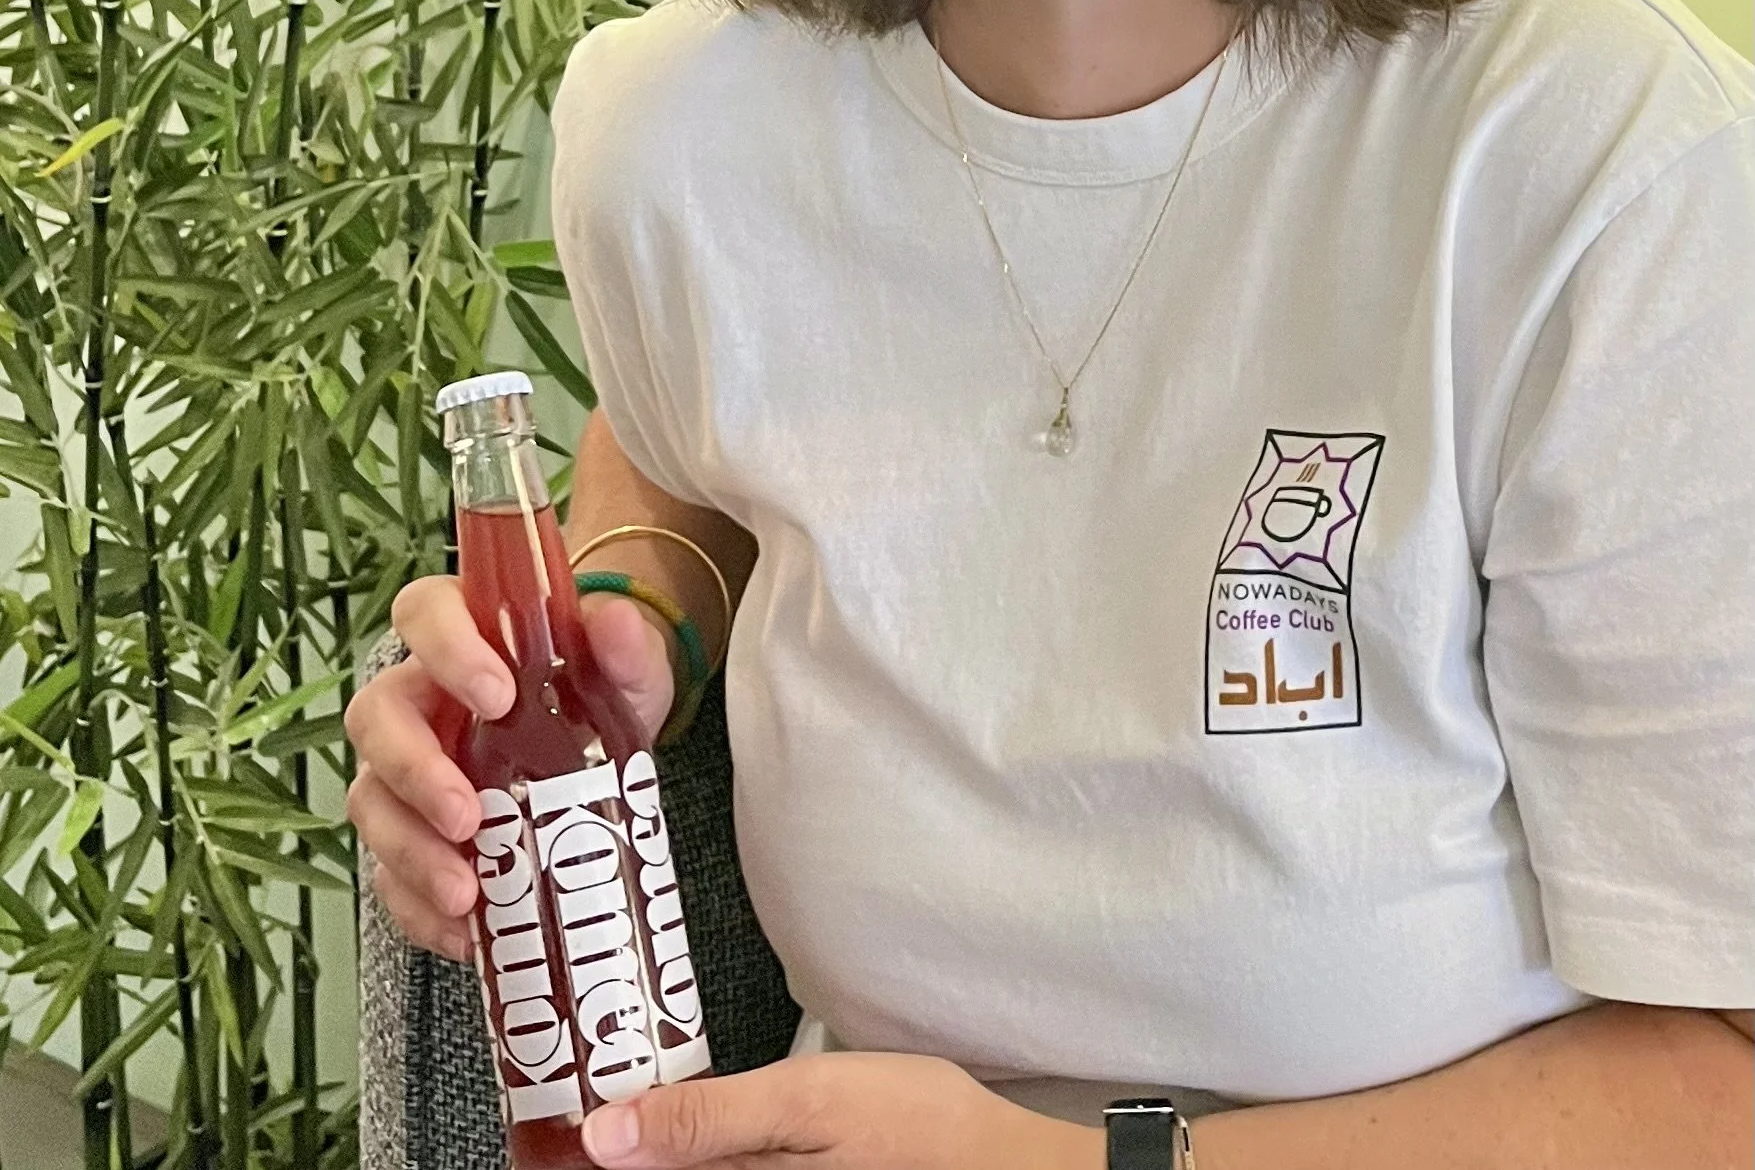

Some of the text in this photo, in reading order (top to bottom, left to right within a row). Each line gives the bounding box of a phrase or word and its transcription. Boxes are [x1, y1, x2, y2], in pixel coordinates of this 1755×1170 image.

[1218, 583, 1338, 614] NOWADAYS
[1216, 609, 1334, 632] Coffee Club
